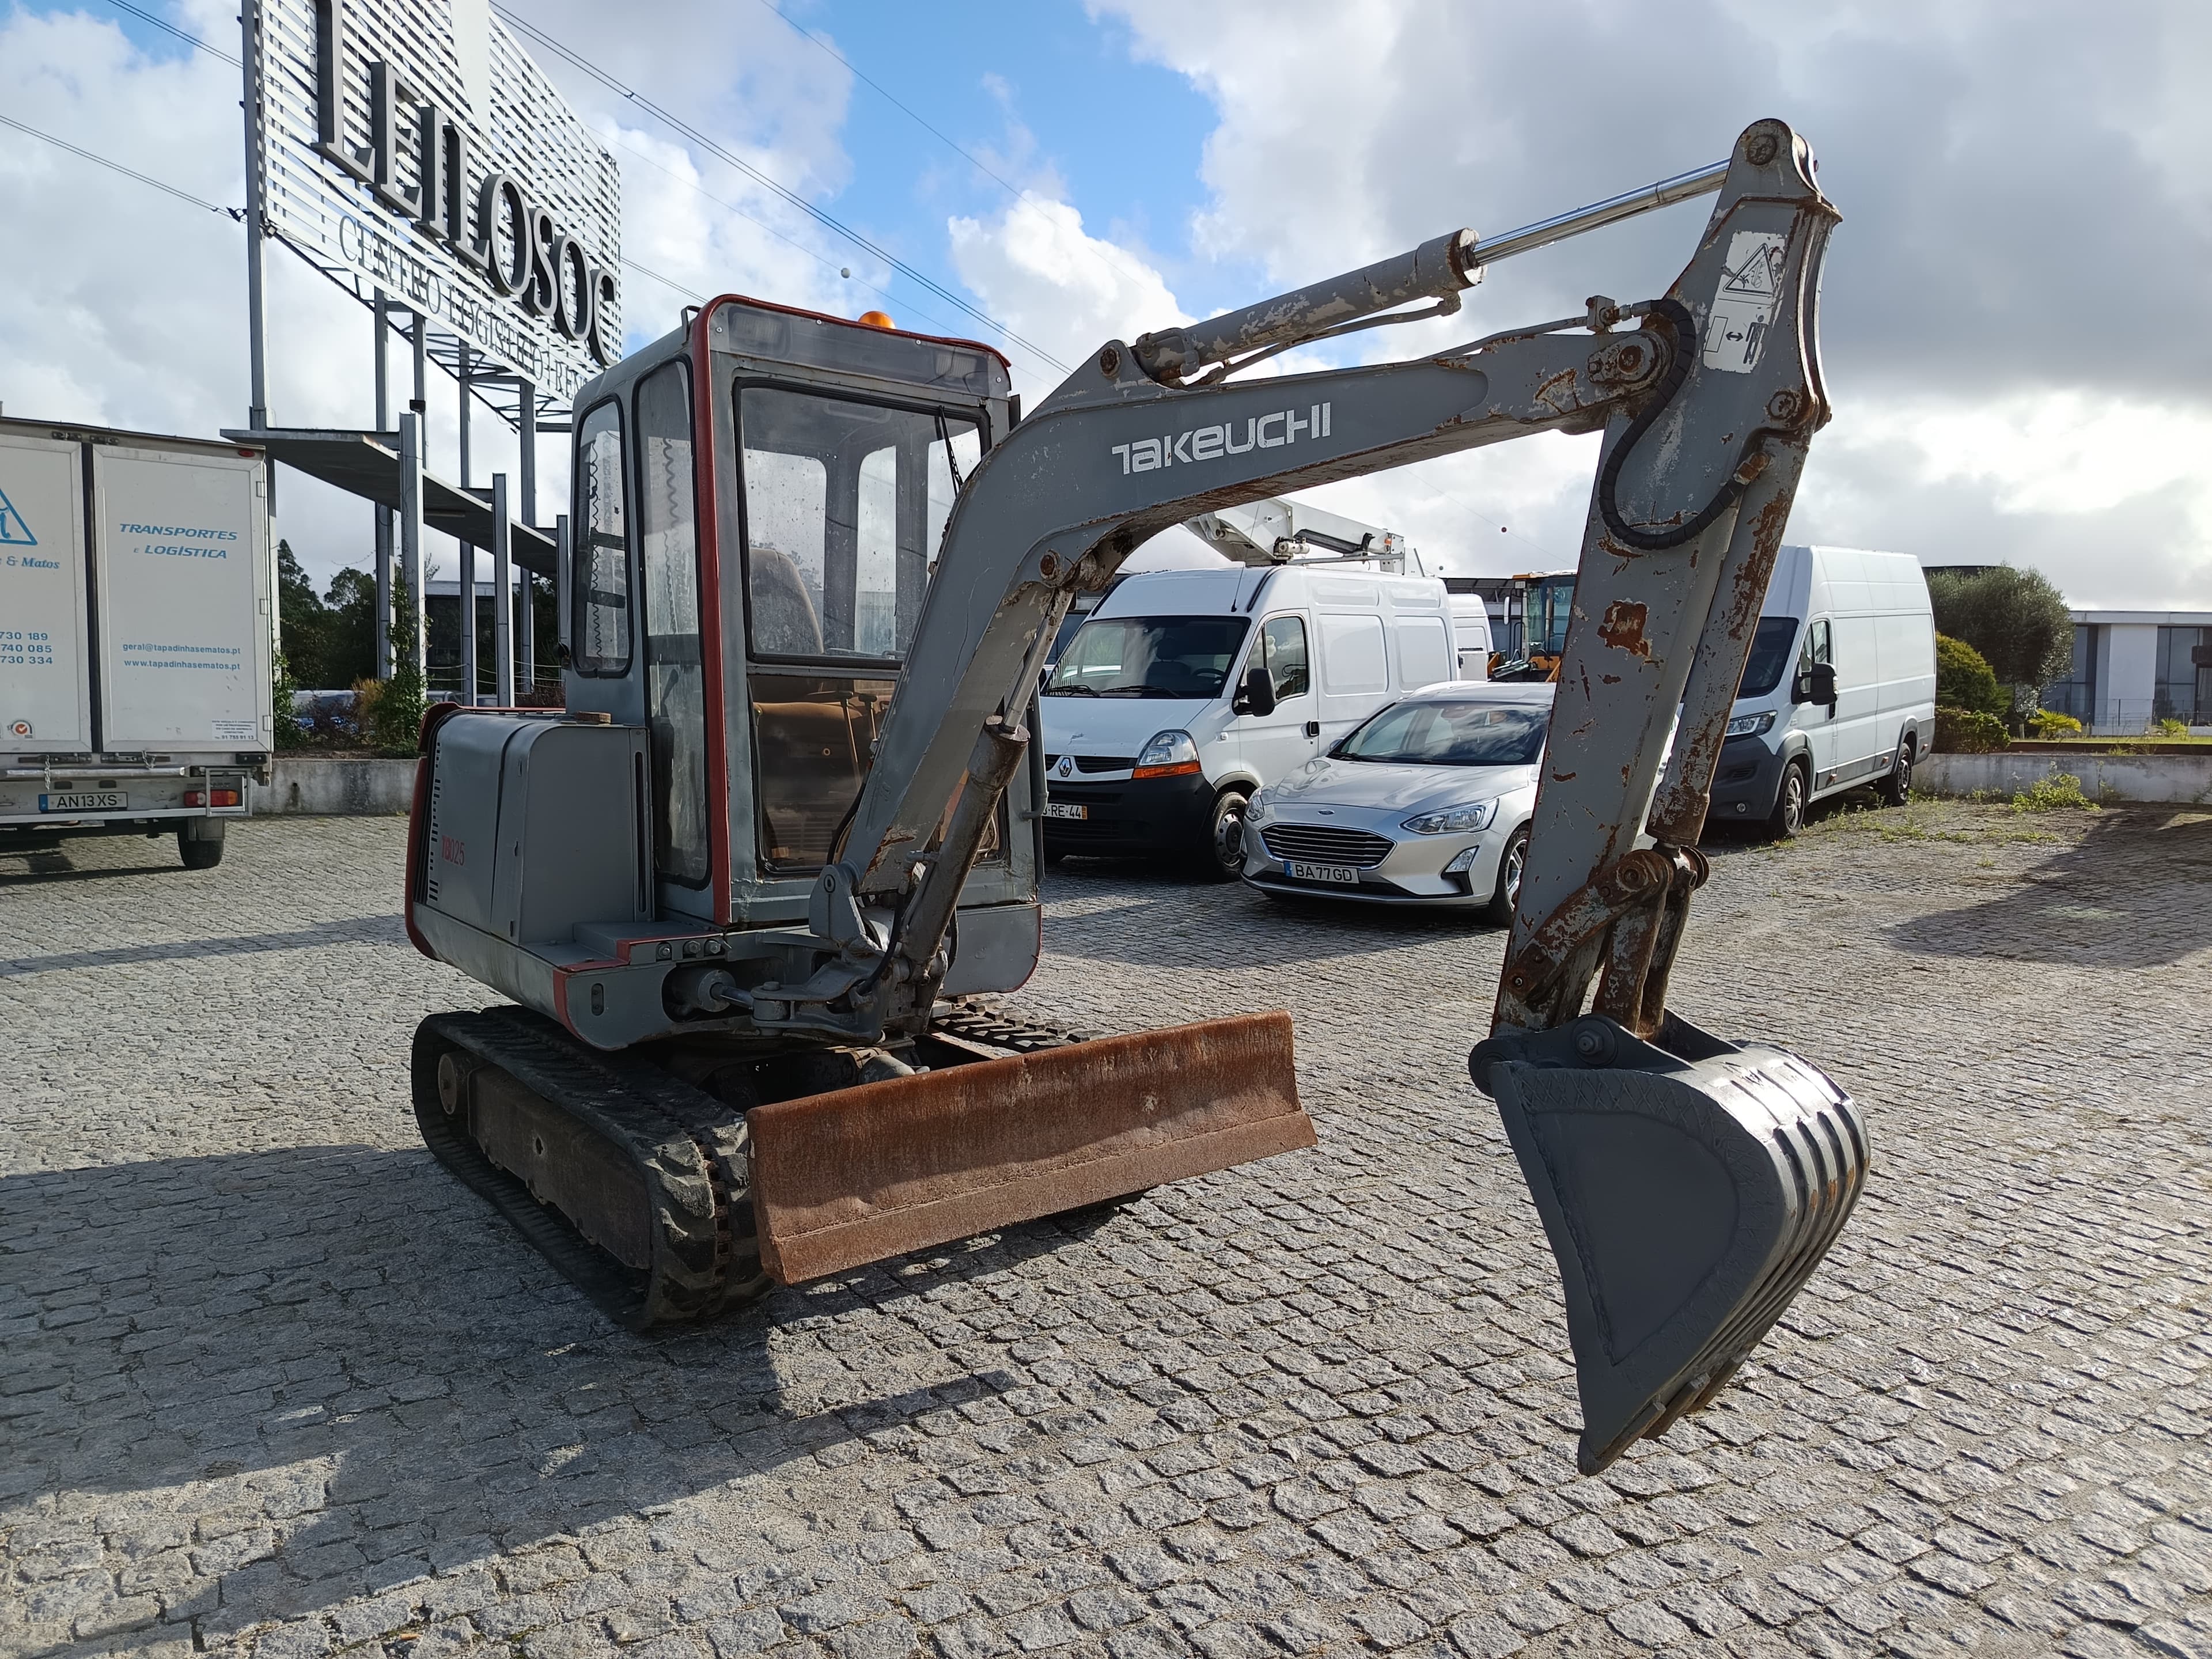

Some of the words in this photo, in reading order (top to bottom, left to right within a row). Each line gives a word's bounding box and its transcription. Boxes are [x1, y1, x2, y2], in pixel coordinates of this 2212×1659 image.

[339, 215, 441, 315] CENTRO
[119, 523, 238, 540] TRANSPORTES
[21, 557, 60, 569] Matos
[27, 632, 48, 641] 189
[1, 644, 23, 652] 740
[28, 645, 52, 653] 085
[123, 643, 241, 656] geral@tapadinhasematos.pt
[0, 656, 24, 664] 730
[29, 656, 52, 664] 334
[124, 660, 240, 671] www.tapadinhasematos.pt
[442, 835, 465, 866] TB025
